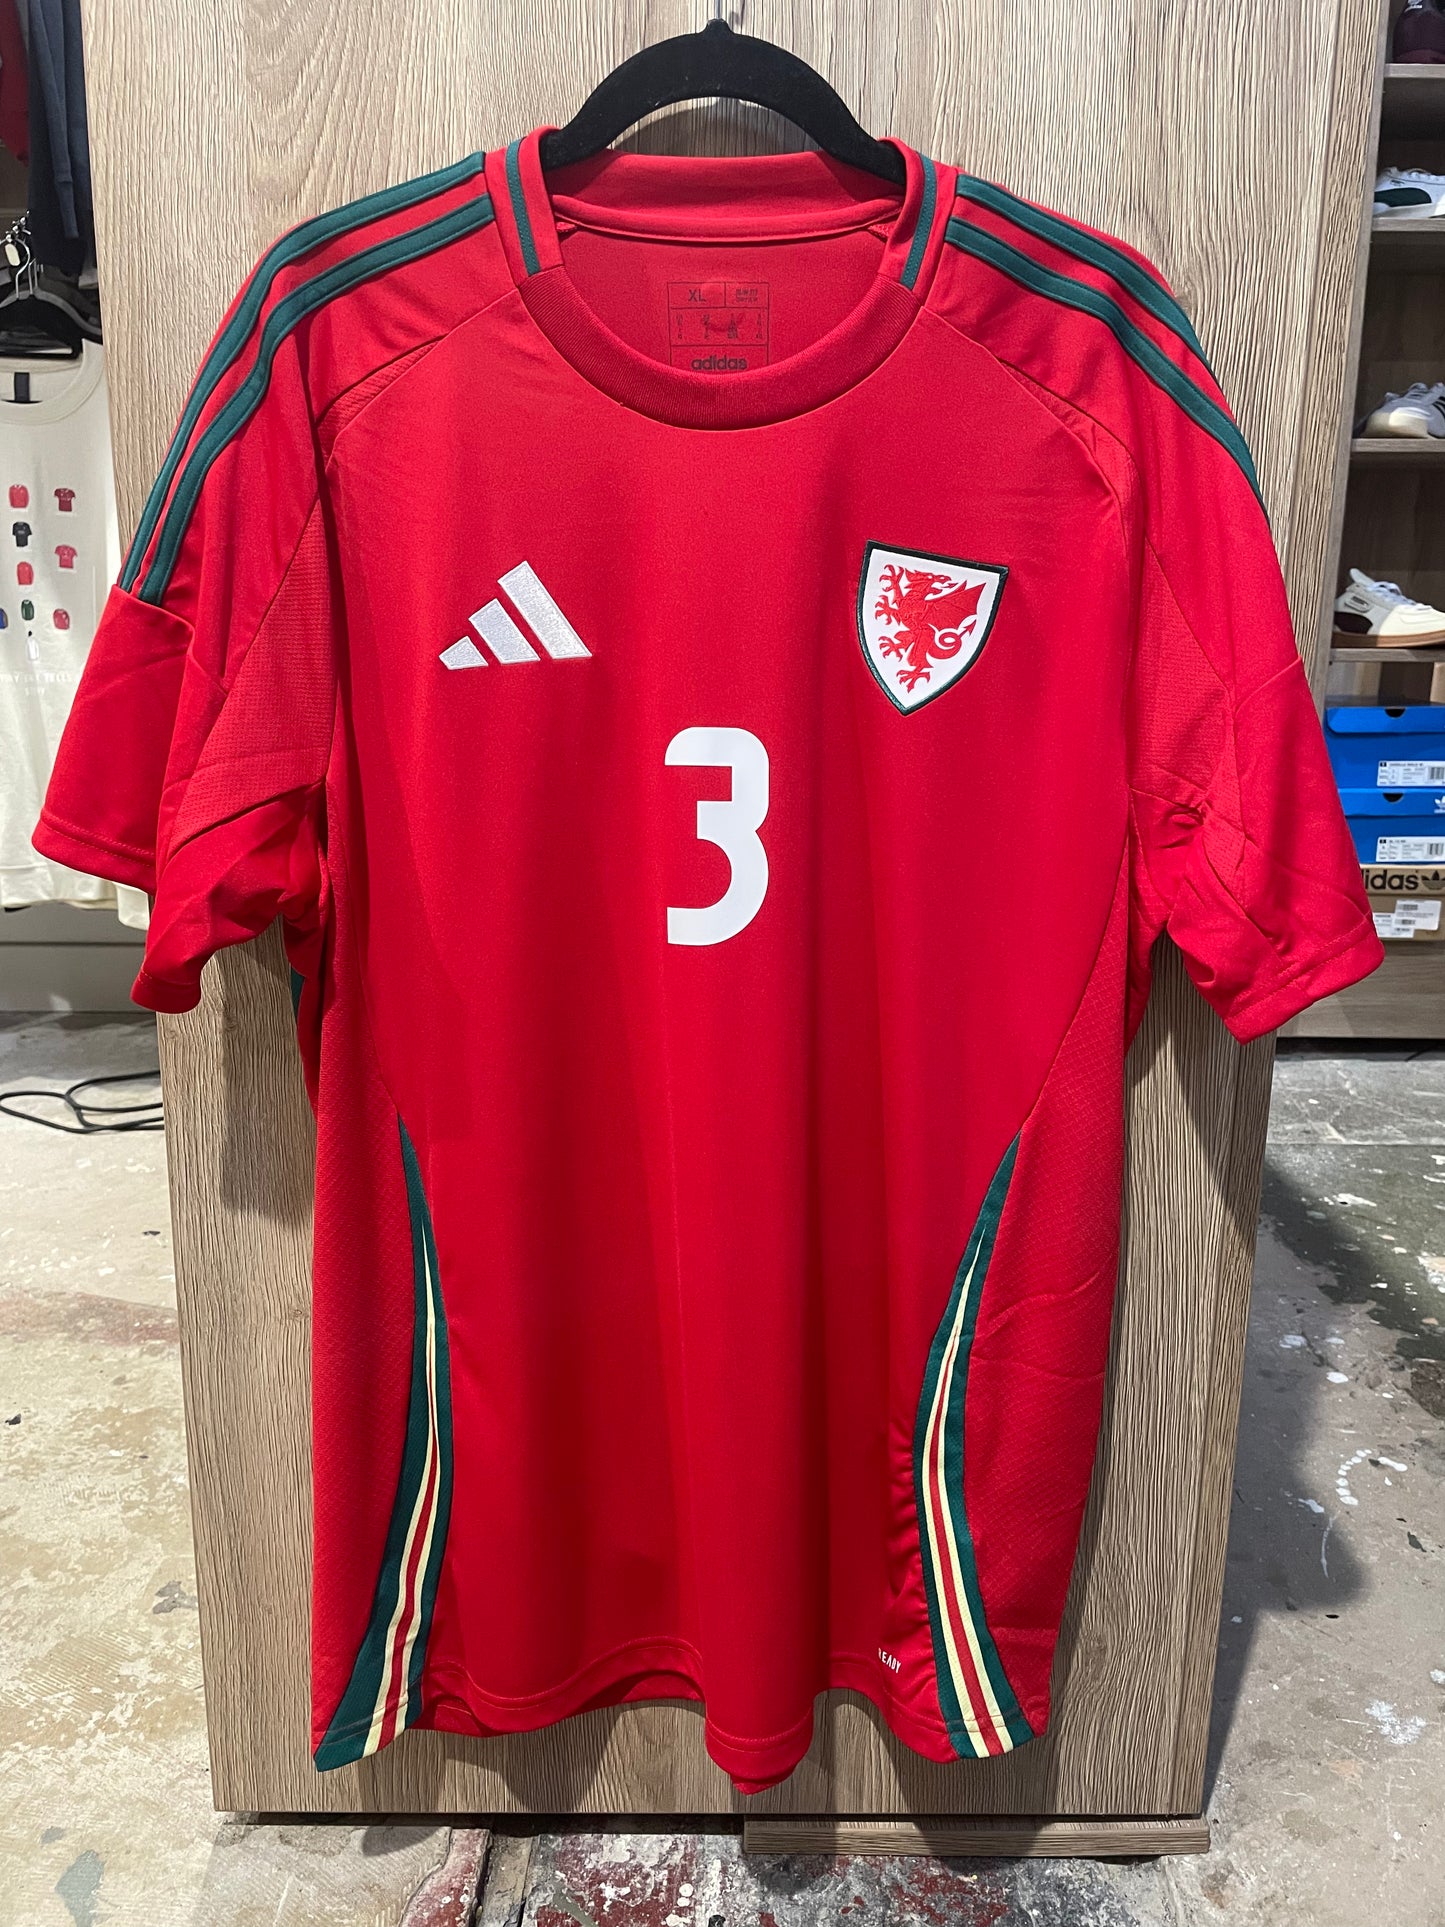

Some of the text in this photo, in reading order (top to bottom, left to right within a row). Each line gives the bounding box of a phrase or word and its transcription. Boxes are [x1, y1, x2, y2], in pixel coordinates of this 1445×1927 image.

[689, 289, 707, 302] XL
[691, 355, 747, 371] adidas
[664, 726, 770, 946] 3
